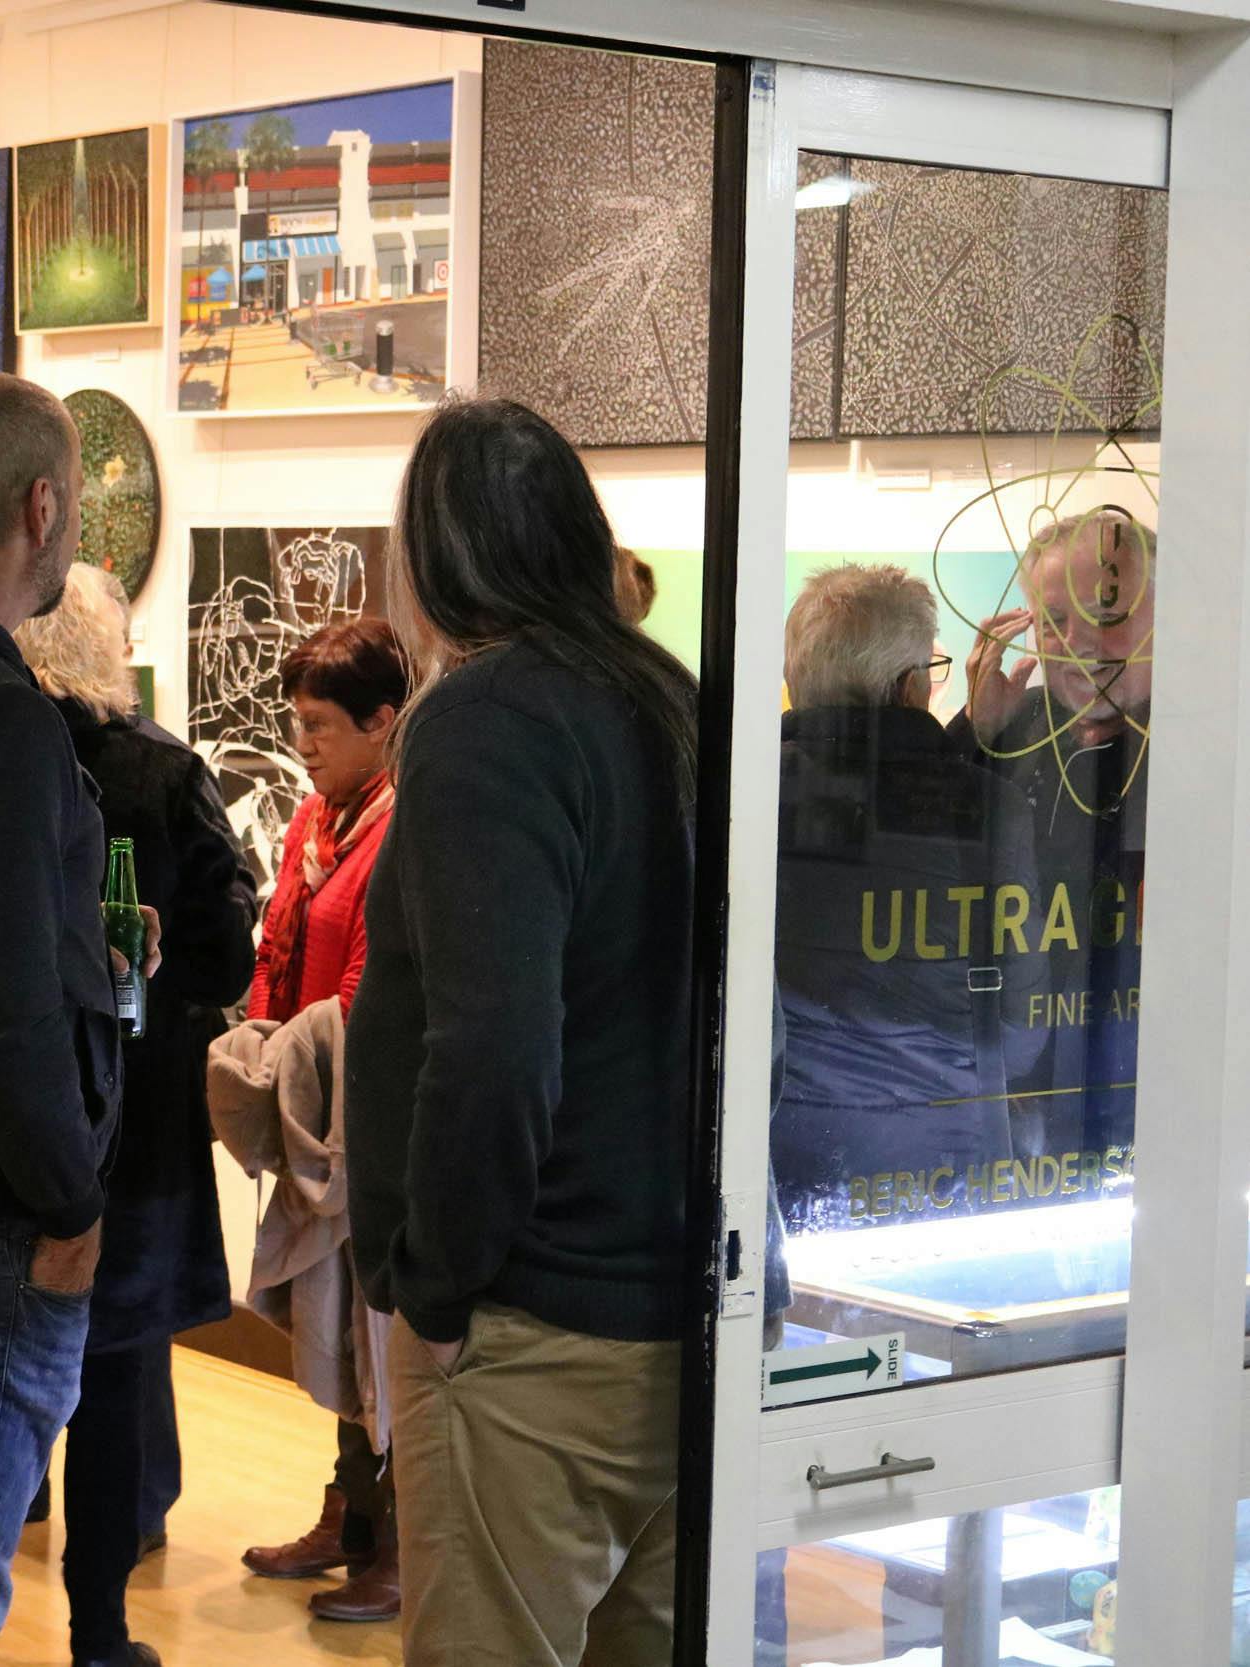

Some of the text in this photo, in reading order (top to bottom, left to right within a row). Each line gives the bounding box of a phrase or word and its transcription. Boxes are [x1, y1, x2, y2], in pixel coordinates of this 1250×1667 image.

[862, 882, 1144, 962] ULTRAG
[1028, 991, 1094, 1029] FINE
[850, 1168, 954, 1219] BERIC
[888, 1339, 898, 1381] SLIDE
